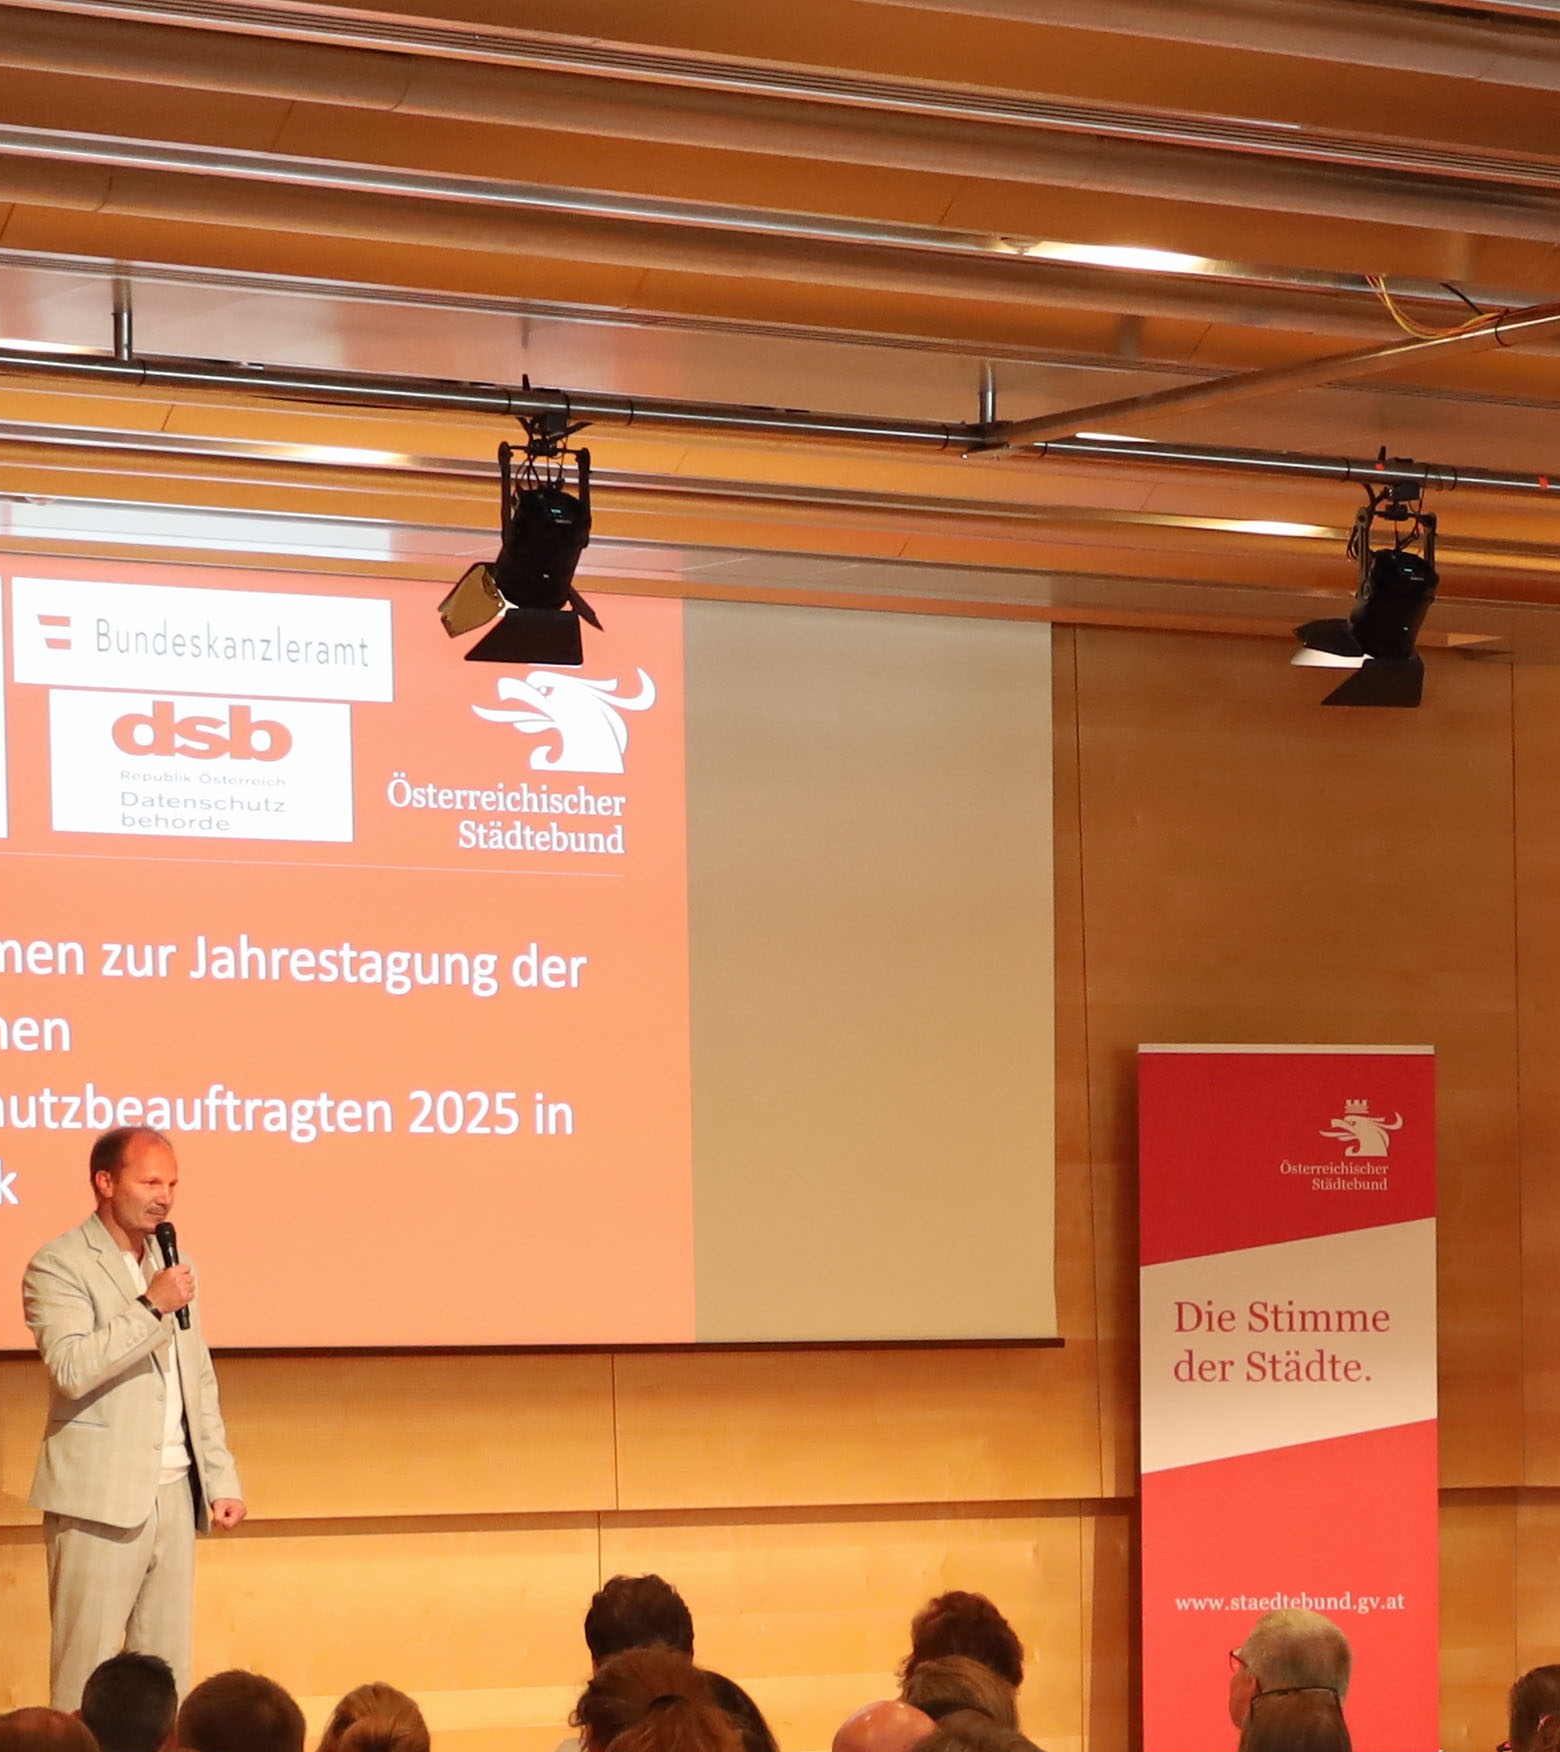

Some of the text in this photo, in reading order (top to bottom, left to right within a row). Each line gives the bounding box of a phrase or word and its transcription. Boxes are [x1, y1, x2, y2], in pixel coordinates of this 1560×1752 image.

[95, 618, 369, 668] Bundeskanzleramt
[111, 700, 293, 762] dsb
[120, 769, 191, 784] Republik
[120, 791, 286, 814] Datenschutz
[386, 772, 627, 817] Österreichischer
[121, 812, 231, 832] behörde
[458, 820, 626, 855] Städtebund
[101, 939, 177, 979] zur
[189, 934, 498, 997] Jahrestagung
[511, 942, 587, 990] der
[408, 1089, 520, 1136] 2025
[534, 1092, 574, 1136] in
[1280, 1159, 1389, 1175] Österreichischer
[1312, 1178, 1387, 1191] Städtebund
[1174, 1300, 1391, 1333] Die Stimme
[1174, 1349, 1373, 1383] der Städte.
[1175, 1592, 1406, 1613] www.staedtebund.gv.at
